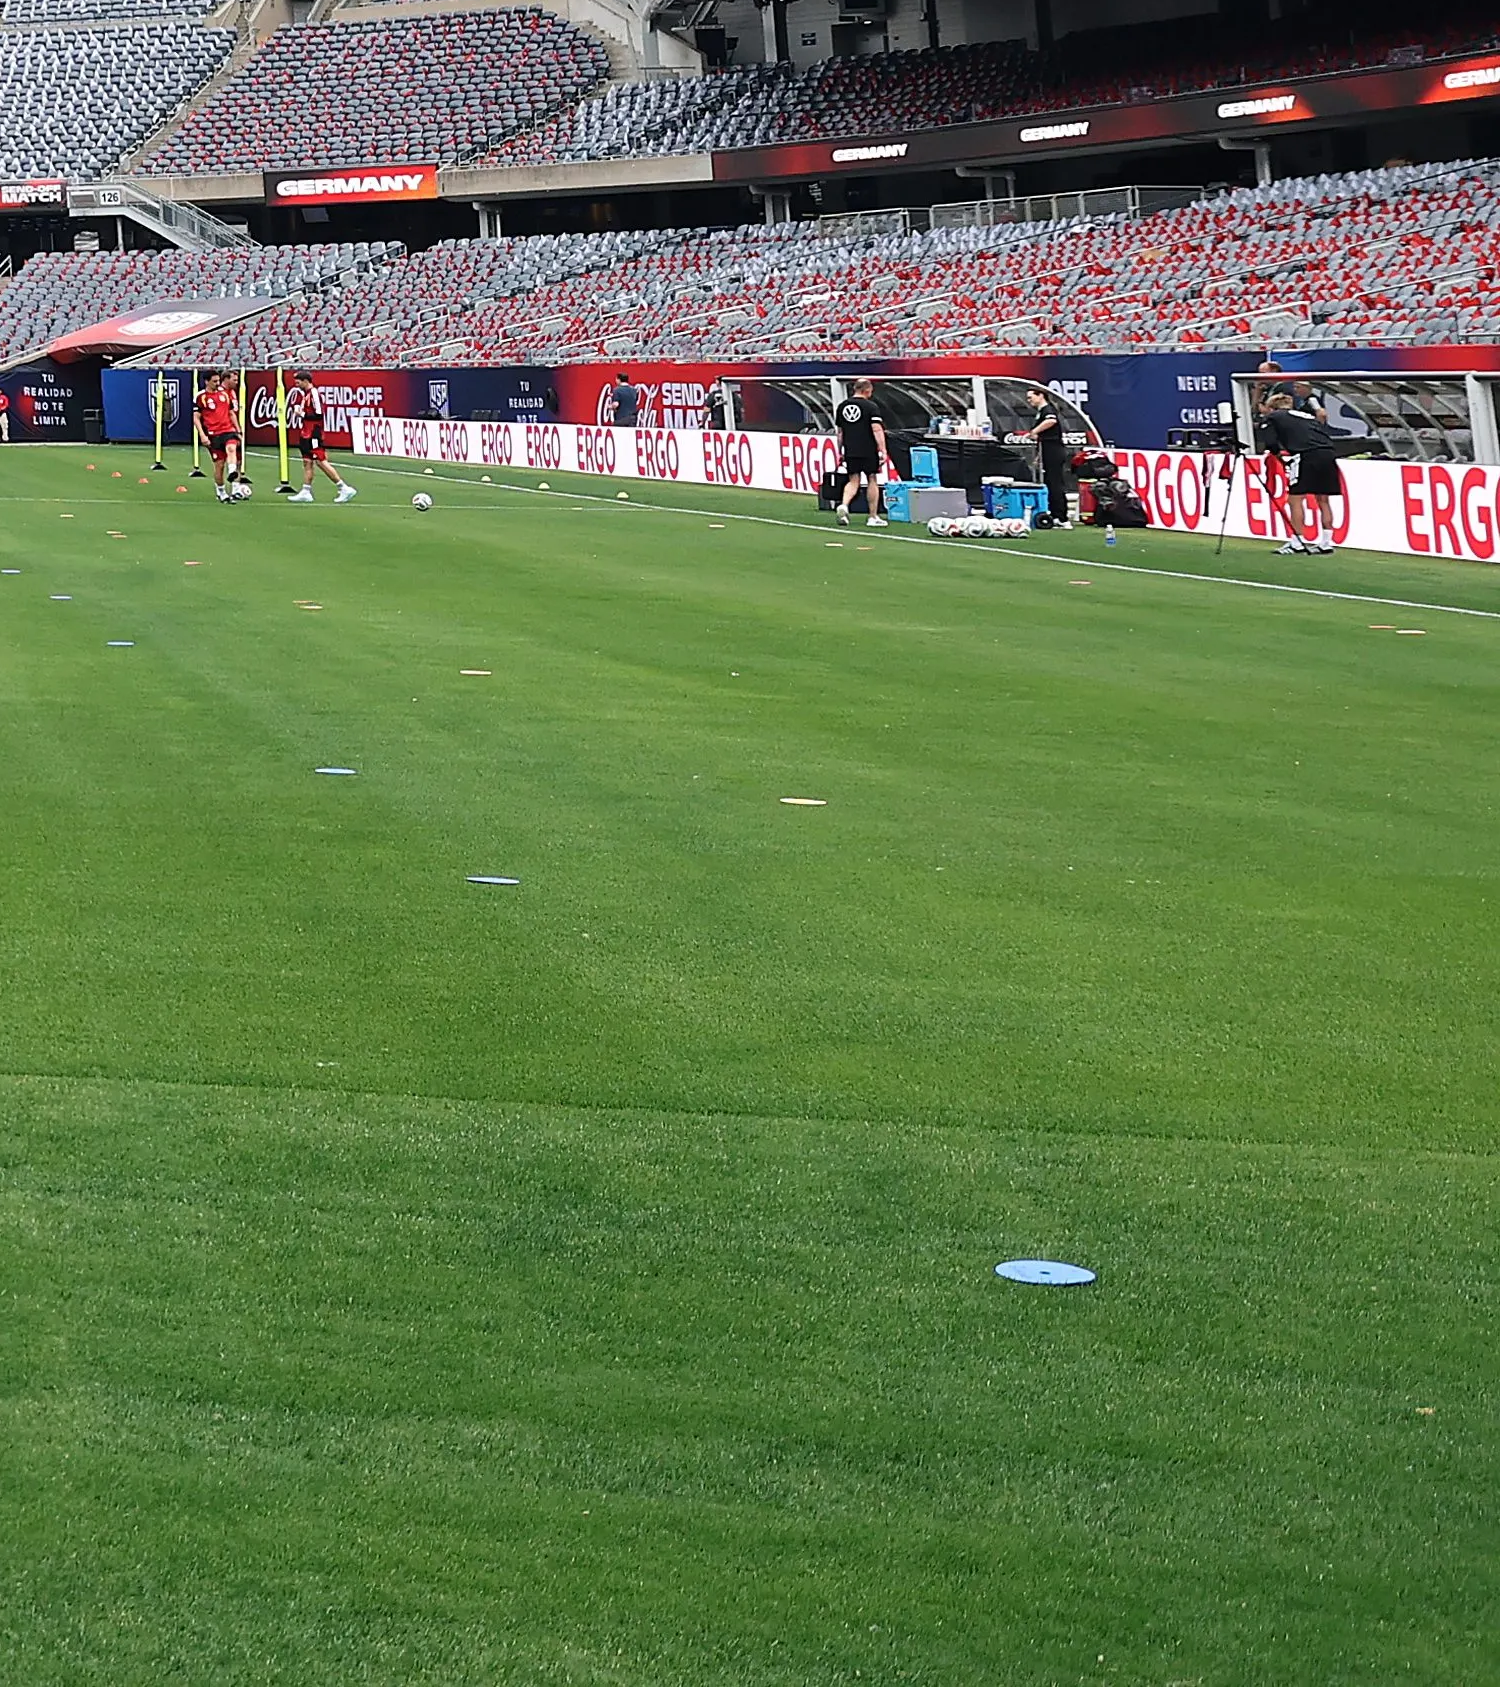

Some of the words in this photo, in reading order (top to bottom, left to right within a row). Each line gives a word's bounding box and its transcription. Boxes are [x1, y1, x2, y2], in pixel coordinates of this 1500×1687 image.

[1218, 95, 1296, 118] GERMANY
[1020, 122, 1089, 142] GERMANY
[832, 143, 908, 162] GERMANY
[1, 185, 62, 195] SEND-OFF
[276, 174, 423, 197] GERMANY
[1, 193, 63, 204] MATCH
[102, 192, 119, 203] 126
[42, 373, 55, 383] TU
[519, 381, 530, 392] TU
[1176, 375, 1217, 392] NEVER
[23, 386, 73, 398] REALIDAD
[431, 383, 447, 407] USA
[35, 401, 50, 411] NO
[53, 402, 64, 411] TE
[509, 398, 544, 409] REALIDAD
[33, 415, 67, 426] LIMITA
[1180, 406, 1218, 423] CHASE
[363, 419, 393, 454] ERGO
[403, 421, 429, 458] ERGO
[439, 422, 468, 462] ERGO
[482, 424, 512, 466] ERGO
[526, 425, 561, 469] ERGO
[577, 427, 616, 474] ERGO
[636, 429, 679, 479] ERGO
[703, 432, 752, 486] ERGO
[1401, 465, 1500, 559] ERG
